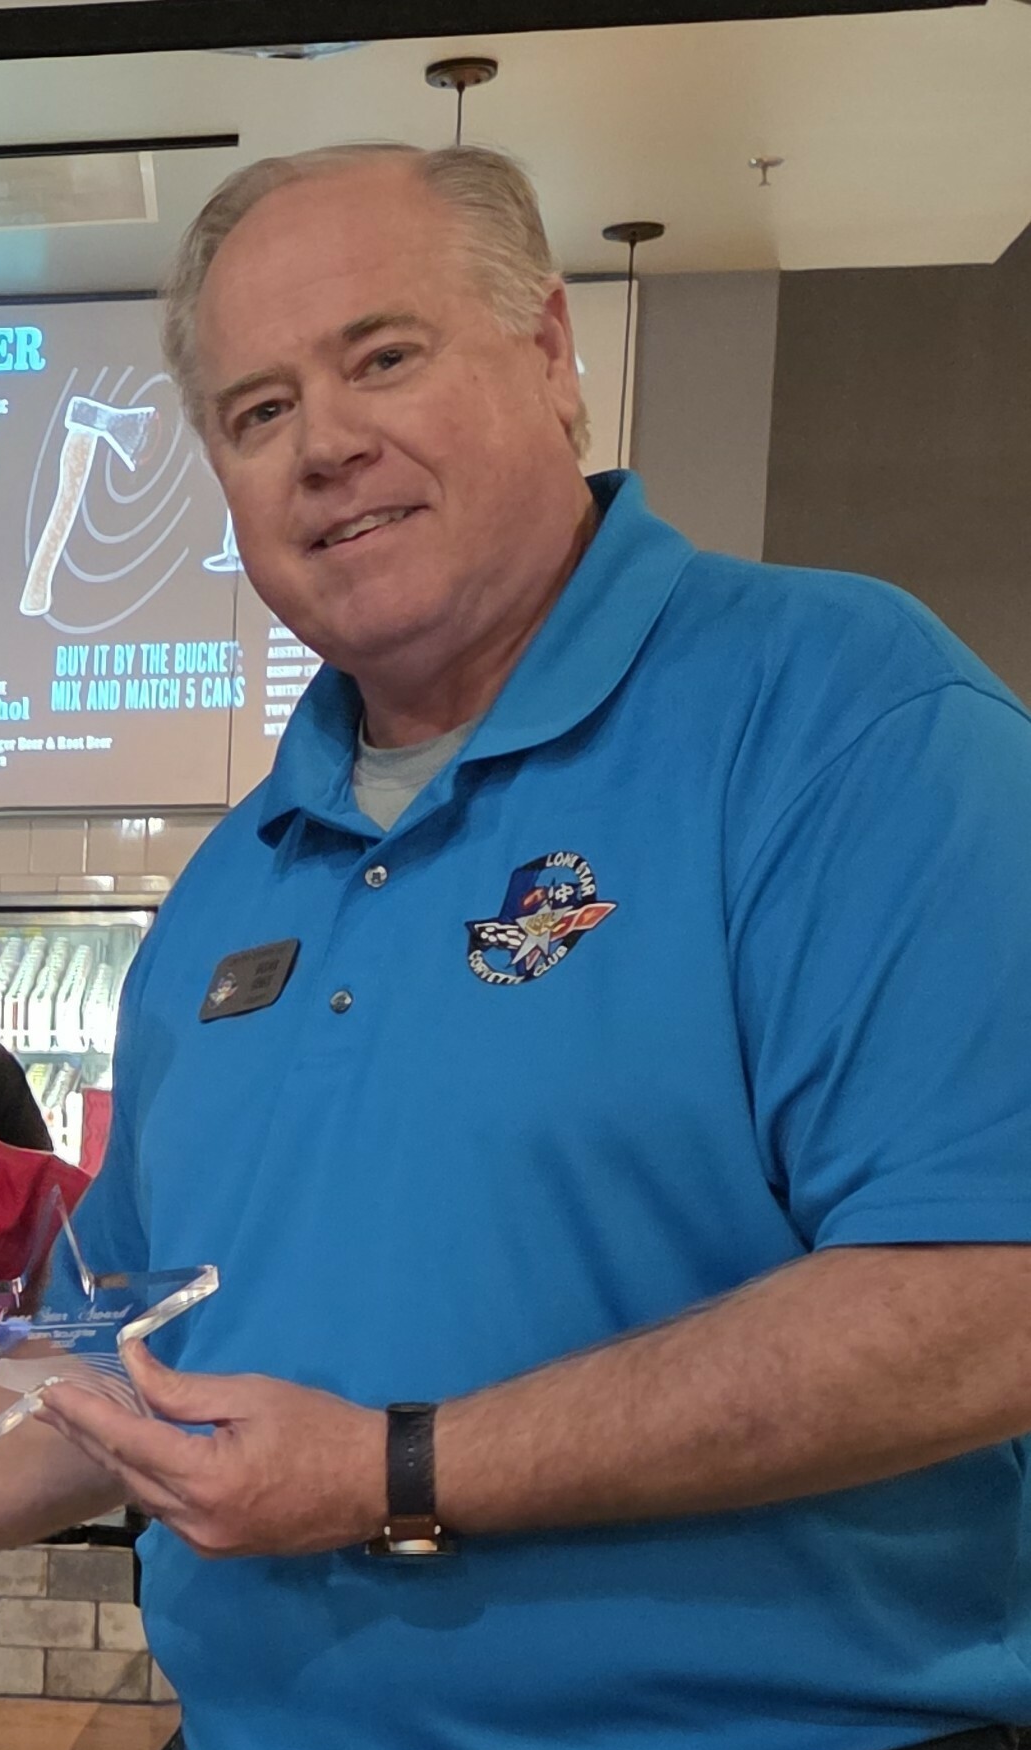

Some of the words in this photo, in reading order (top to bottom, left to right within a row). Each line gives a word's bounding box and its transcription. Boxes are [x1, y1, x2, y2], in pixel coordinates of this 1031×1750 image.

[55, 645, 89, 677] BUY
[93, 644, 110, 676] IT
[113, 644, 136, 675] BY
[140, 643, 171, 675] THE
[174, 641, 244, 674] BUCKET:
[51, 680, 82, 711] MIX
[86, 679, 120, 711] AND
[125, 678, 181, 709] MATCH
[185, 677, 196, 709] 5
[201, 676, 246, 709] CANS
[545, 852, 579, 869] LONE
[575, 861, 596, 897] STAR
[533, 945, 568, 977] CLUB
